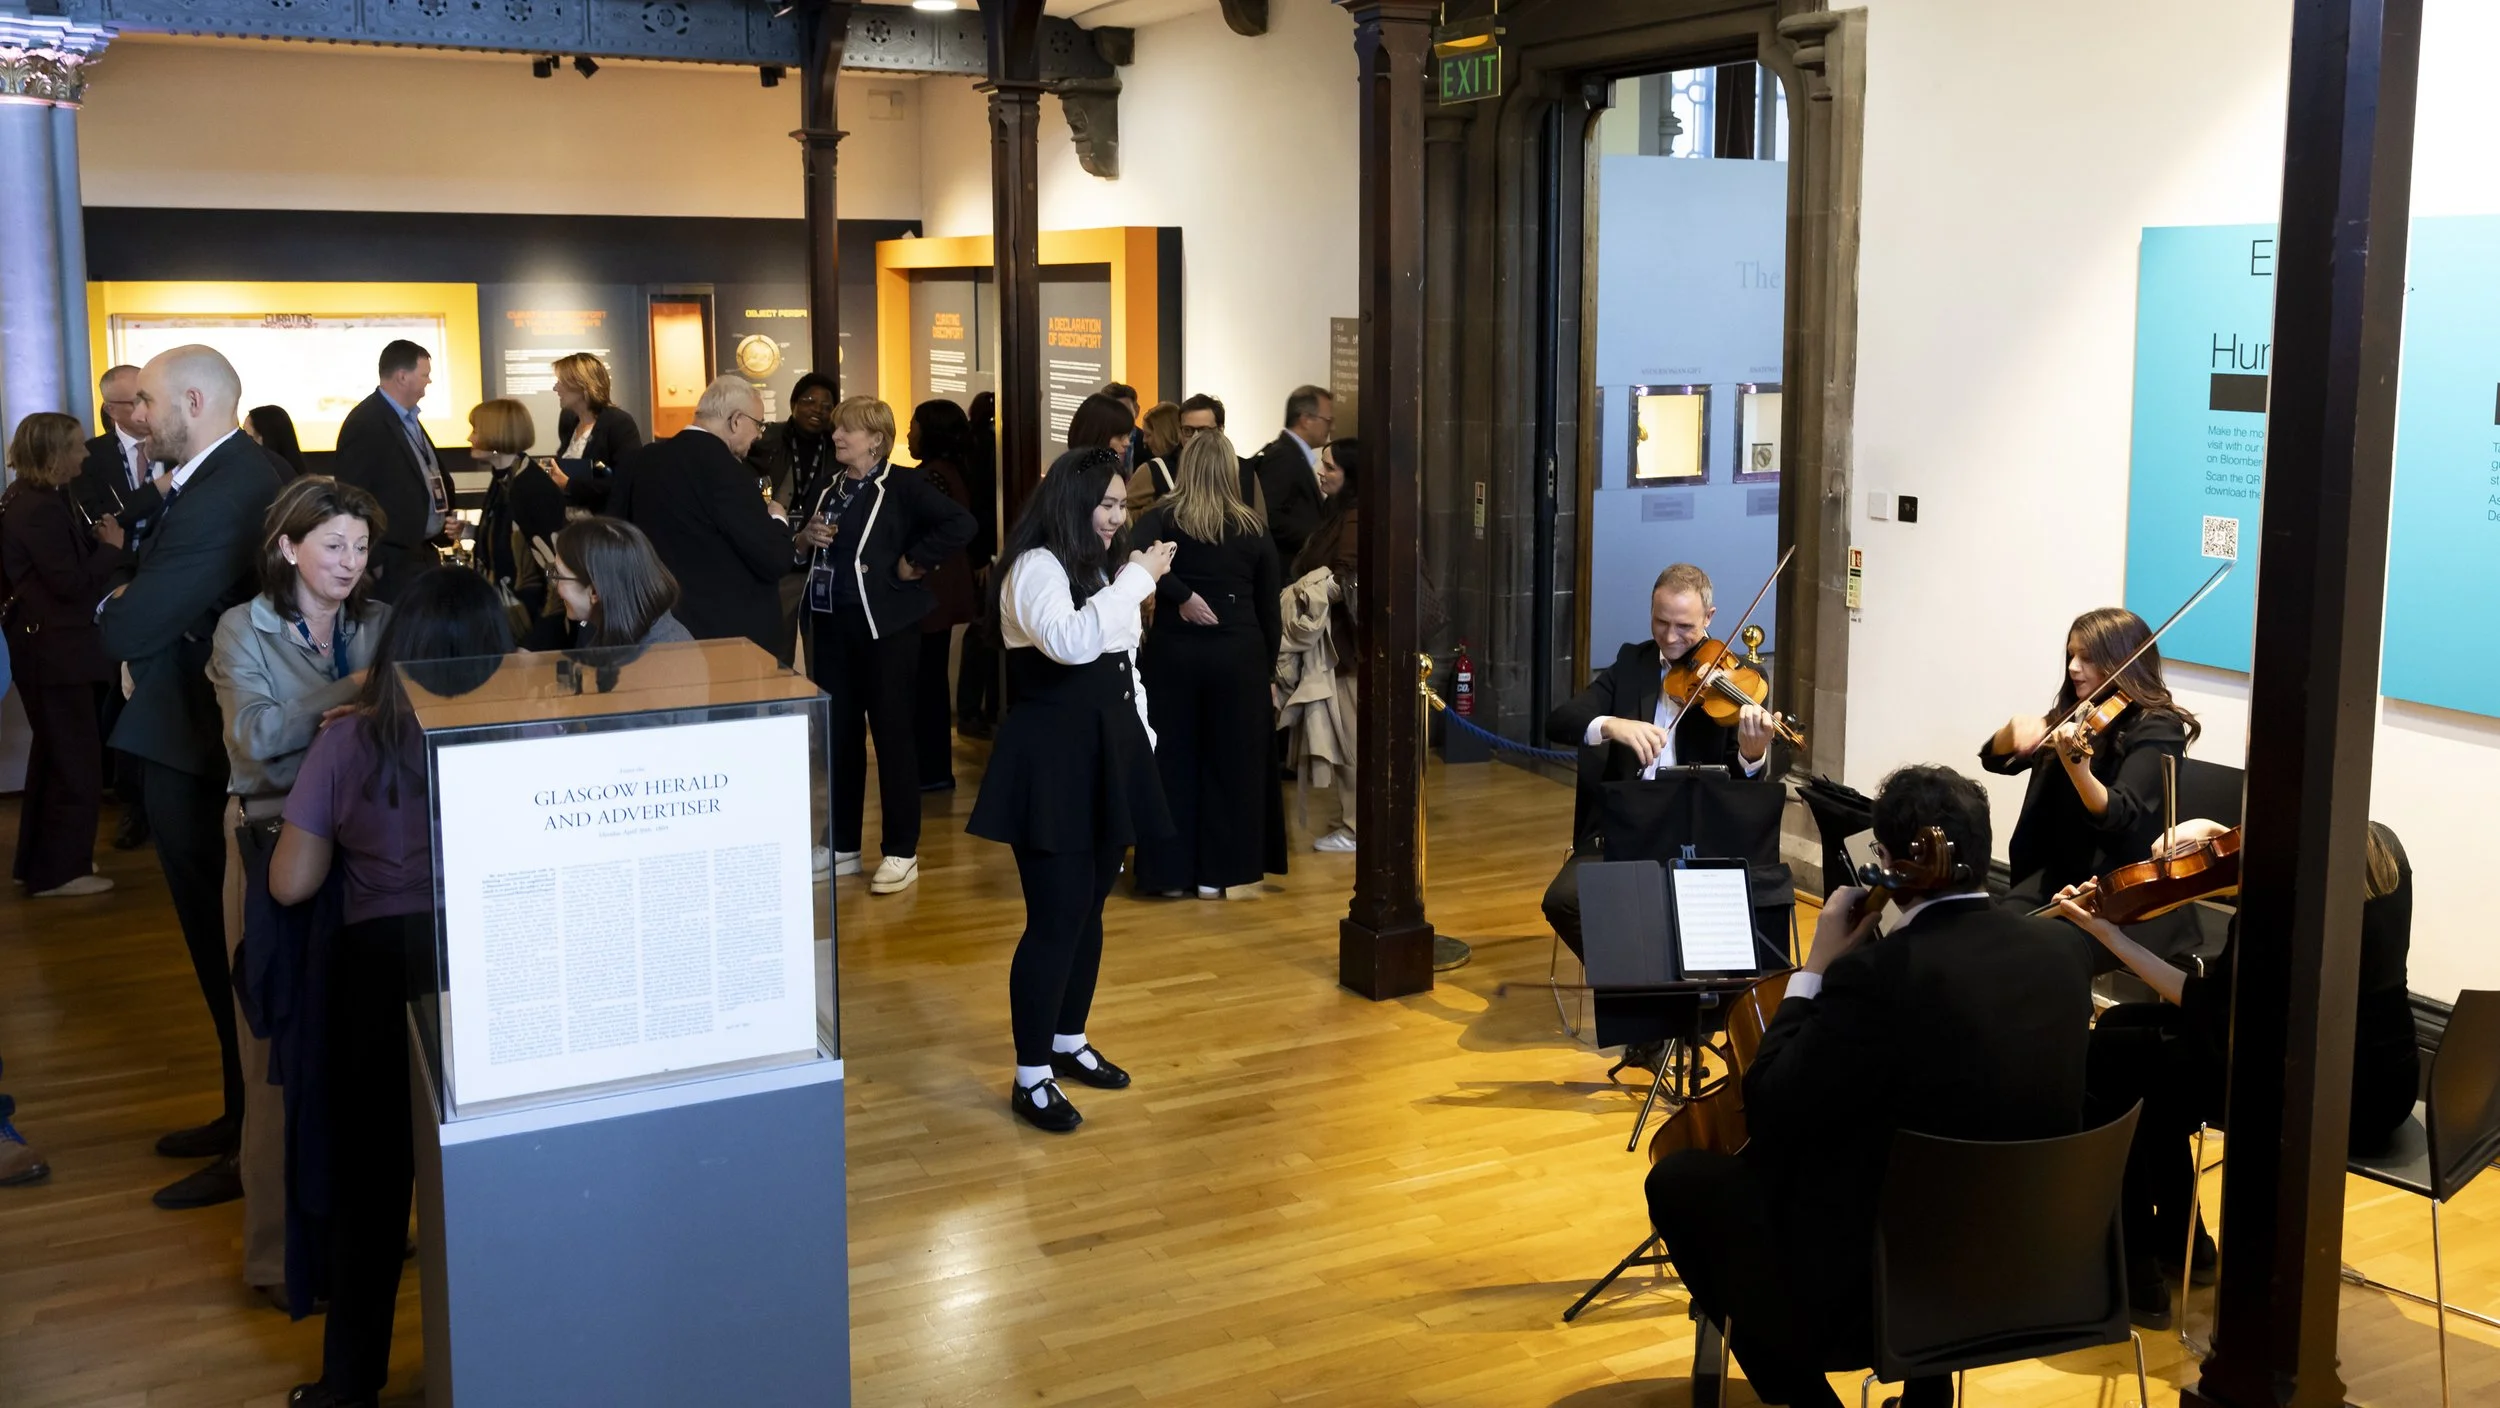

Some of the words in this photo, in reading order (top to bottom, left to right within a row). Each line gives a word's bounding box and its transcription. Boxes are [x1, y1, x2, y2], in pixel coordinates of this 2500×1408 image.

[1443, 54, 1497, 98] EXIT
[2250, 239, 2273, 276] E
[1735, 260, 1780, 290] The
[265, 313, 312, 324] CURATING
[745, 309, 777, 318] OBJECT
[1055, 318, 1101, 332] DECLARATION
[1049, 332, 1057, 345] OF
[1058, 333, 1102, 348] DISCOMFORT
[2208, 425, 2231, 436] Make
[2233, 427, 2247, 437] the
[2207, 440, 2223, 450] visit
[2225, 441, 2242, 451] with
[2245, 444, 2259, 452] our
[2206, 455, 2218, 463] on
[2206, 471, 2228, 481] Scan
[2230, 474, 2243, 483] the
[2246, 474, 2261, 485] QR
[2205, 485, 2247, 498] download
[535, 782, 639, 806] GLASGOW
[646, 774, 728, 796] HERALD
[545, 811, 591, 831] AND
[598, 798, 721, 825] ADVERTISER
